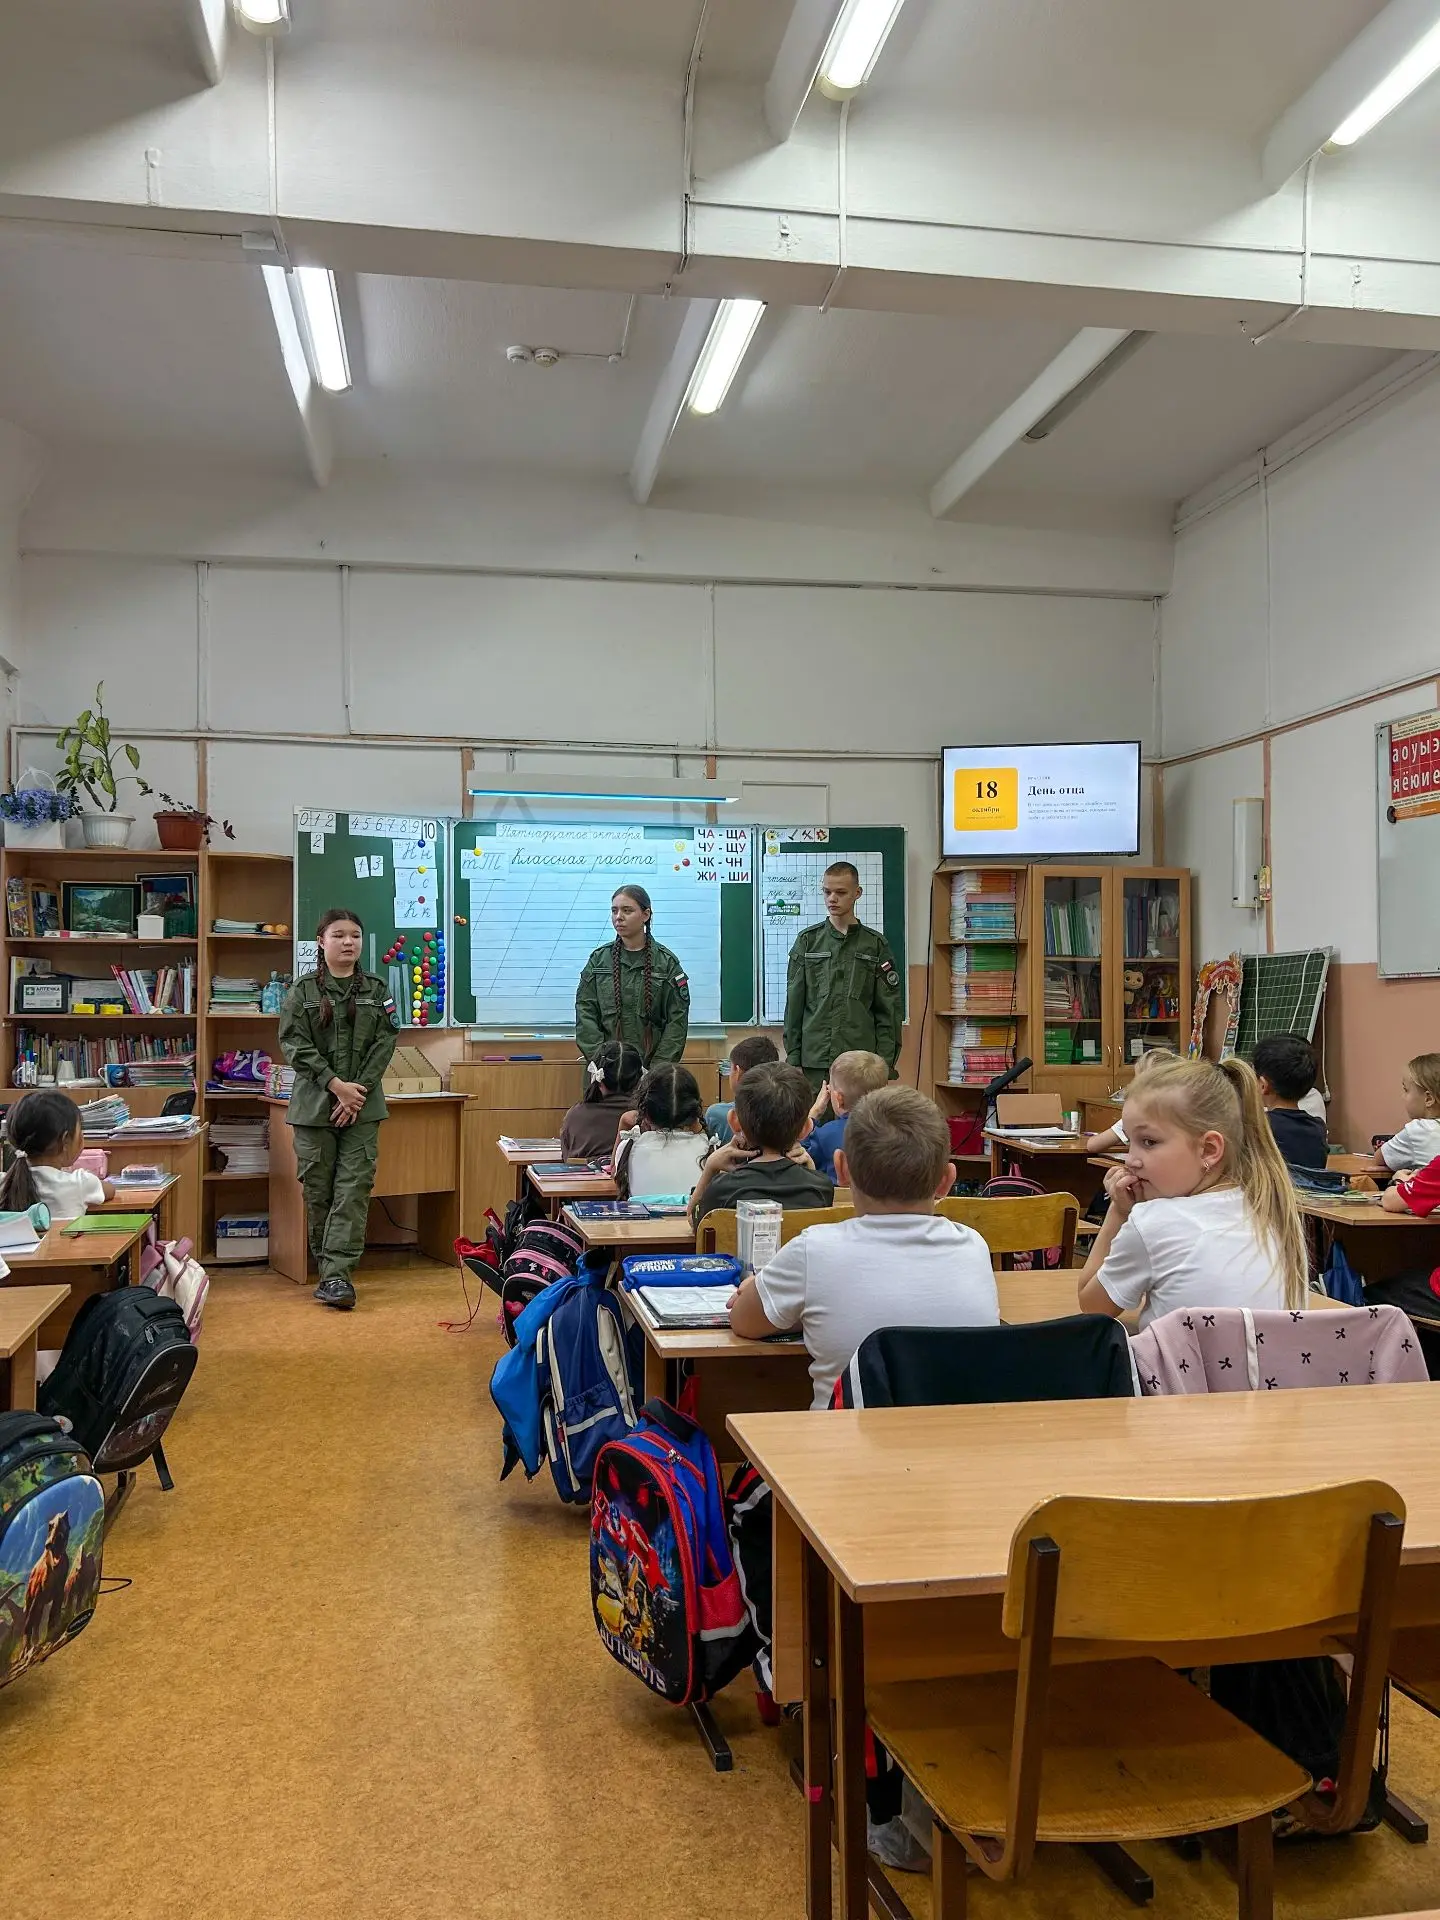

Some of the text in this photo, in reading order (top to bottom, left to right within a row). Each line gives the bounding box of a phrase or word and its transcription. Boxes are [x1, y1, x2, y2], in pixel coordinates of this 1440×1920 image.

[976, 781, 998, 799] 18
[1028, 786, 1085, 797] День отца
[424, 822, 436, 840] 10
[499, 825, 642, 845] Пятнадцатое октября
[698, 829, 715, 839] ЧА
[727, 830, 747, 841] ЩА
[699, 843, 715, 853] ЧУ
[726, 843, 746, 855] ЩУ
[512, 848, 656, 873] Классная работа
[699, 857, 715, 867] ЧК
[726, 858, 743, 868] ЧН
[697, 872, 717, 882] ЖИ
[729, 872, 749, 882] ШИ
